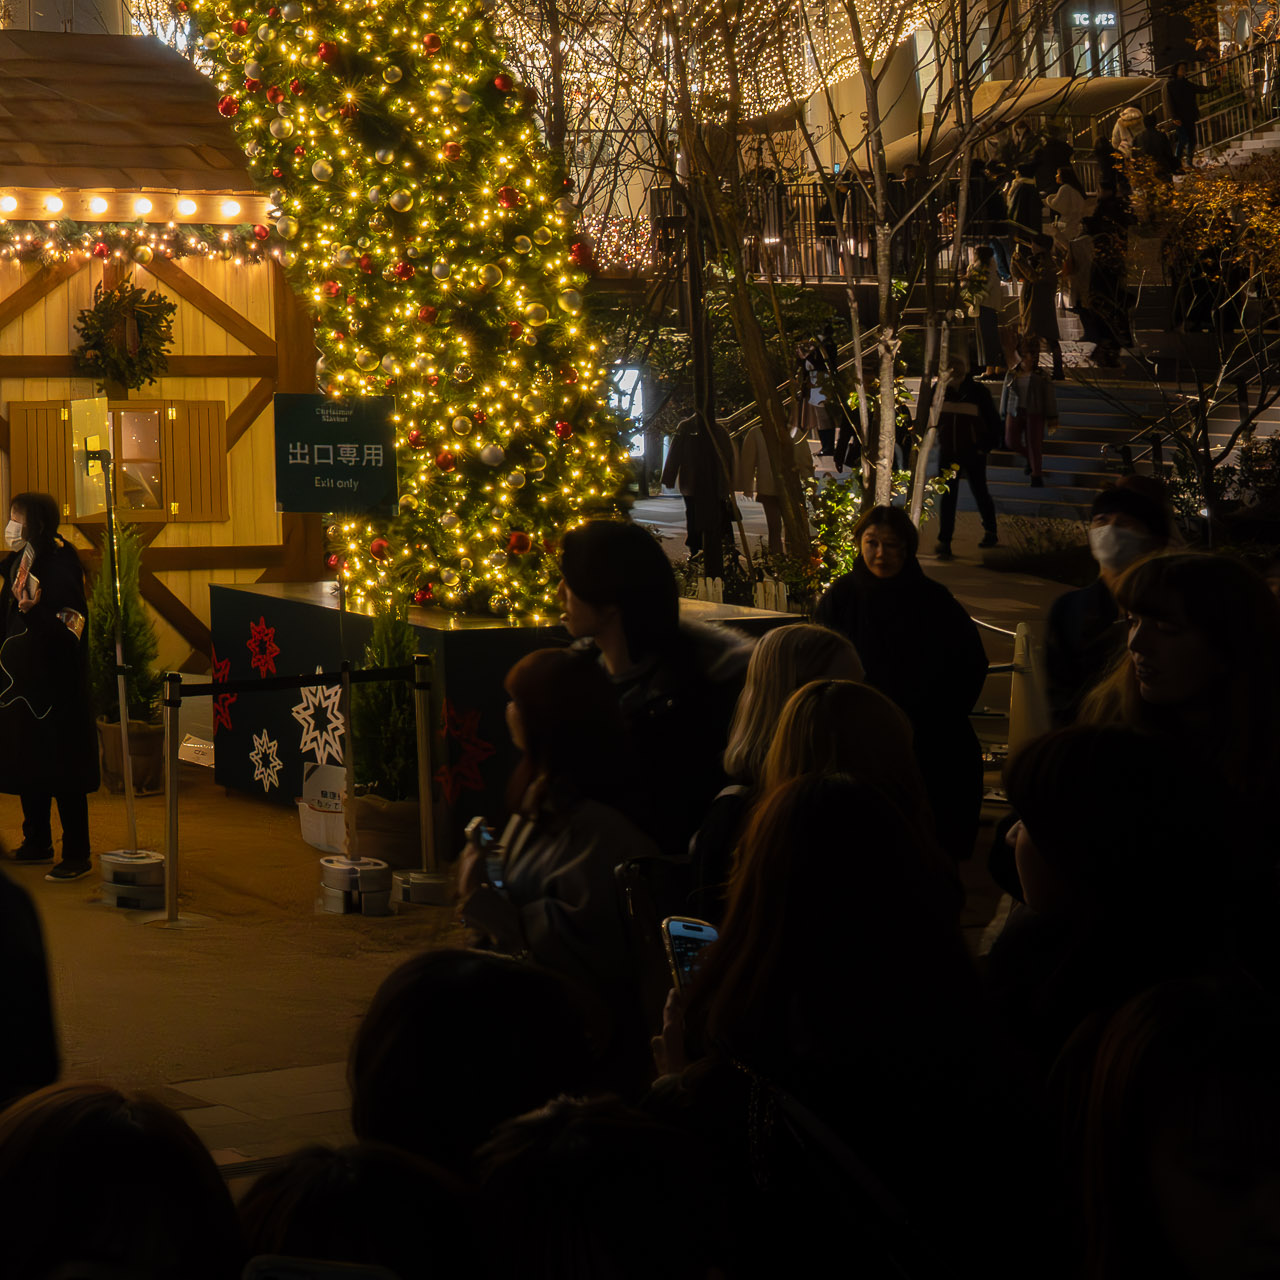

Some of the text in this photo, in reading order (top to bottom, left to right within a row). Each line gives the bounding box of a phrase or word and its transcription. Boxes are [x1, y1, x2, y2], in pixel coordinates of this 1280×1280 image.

[288, 442, 384, 467] 出口専用
[314, 476, 360, 492] Exit only
